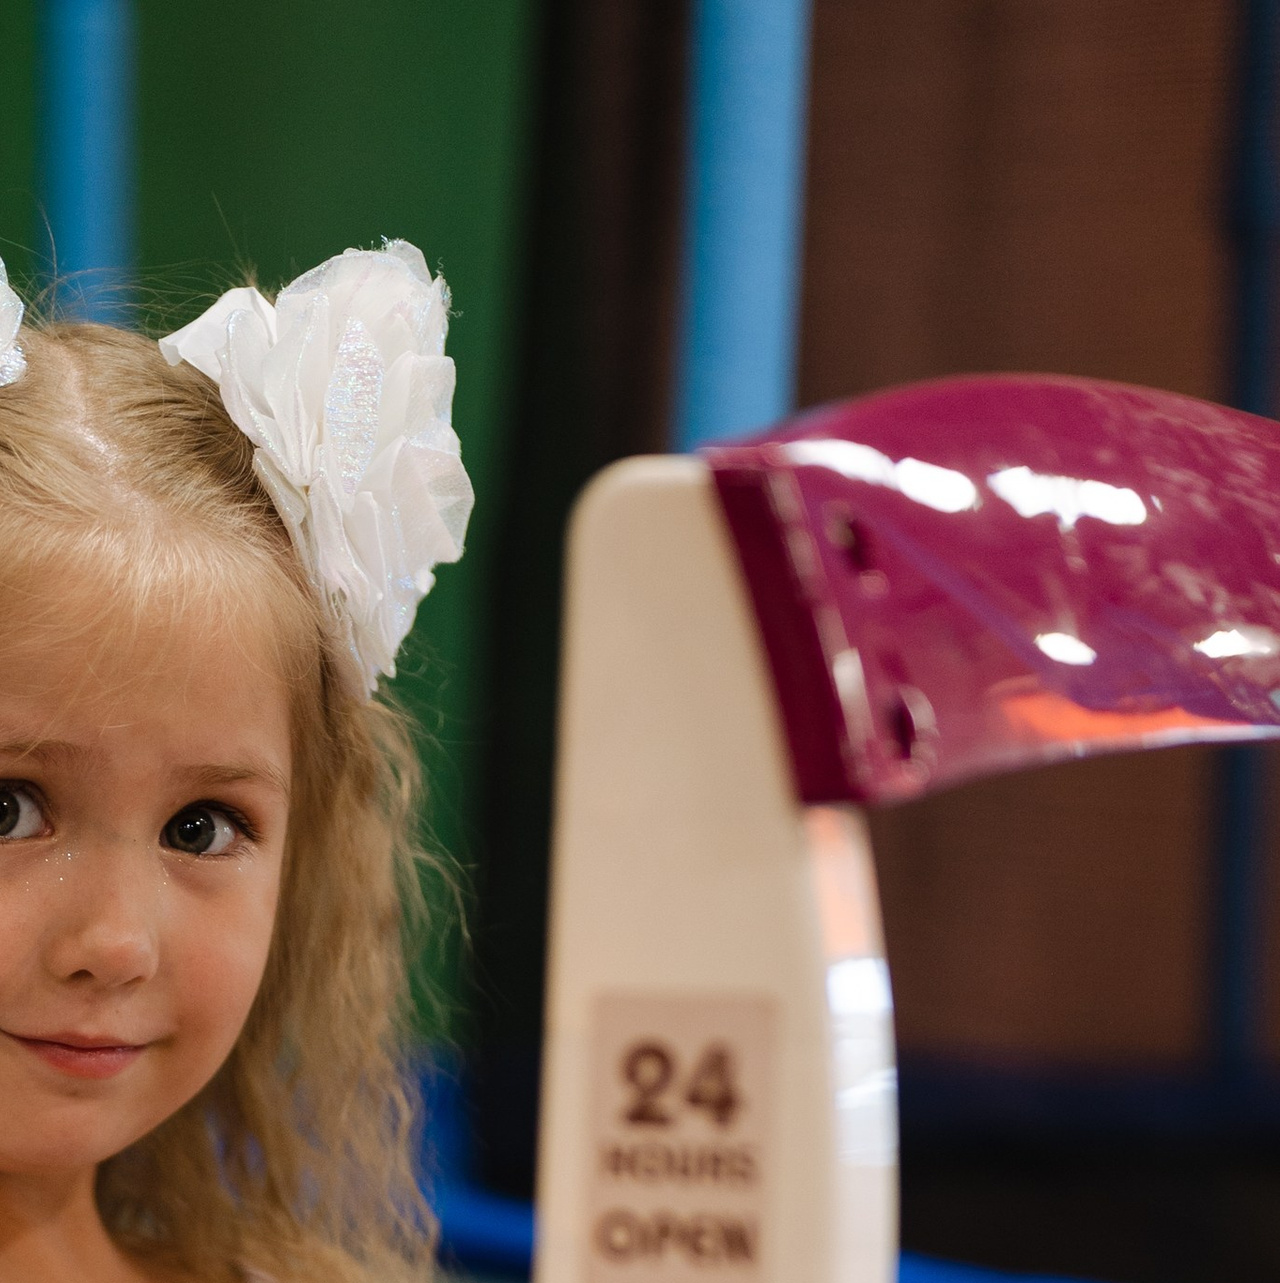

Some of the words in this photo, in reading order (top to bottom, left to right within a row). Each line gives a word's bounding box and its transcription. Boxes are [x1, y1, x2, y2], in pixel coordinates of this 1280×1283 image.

[621, 1037, 741, 1129] 24
[601, 1143, 758, 1184] HOURS
[596, 1209, 757, 1263] OPEN
